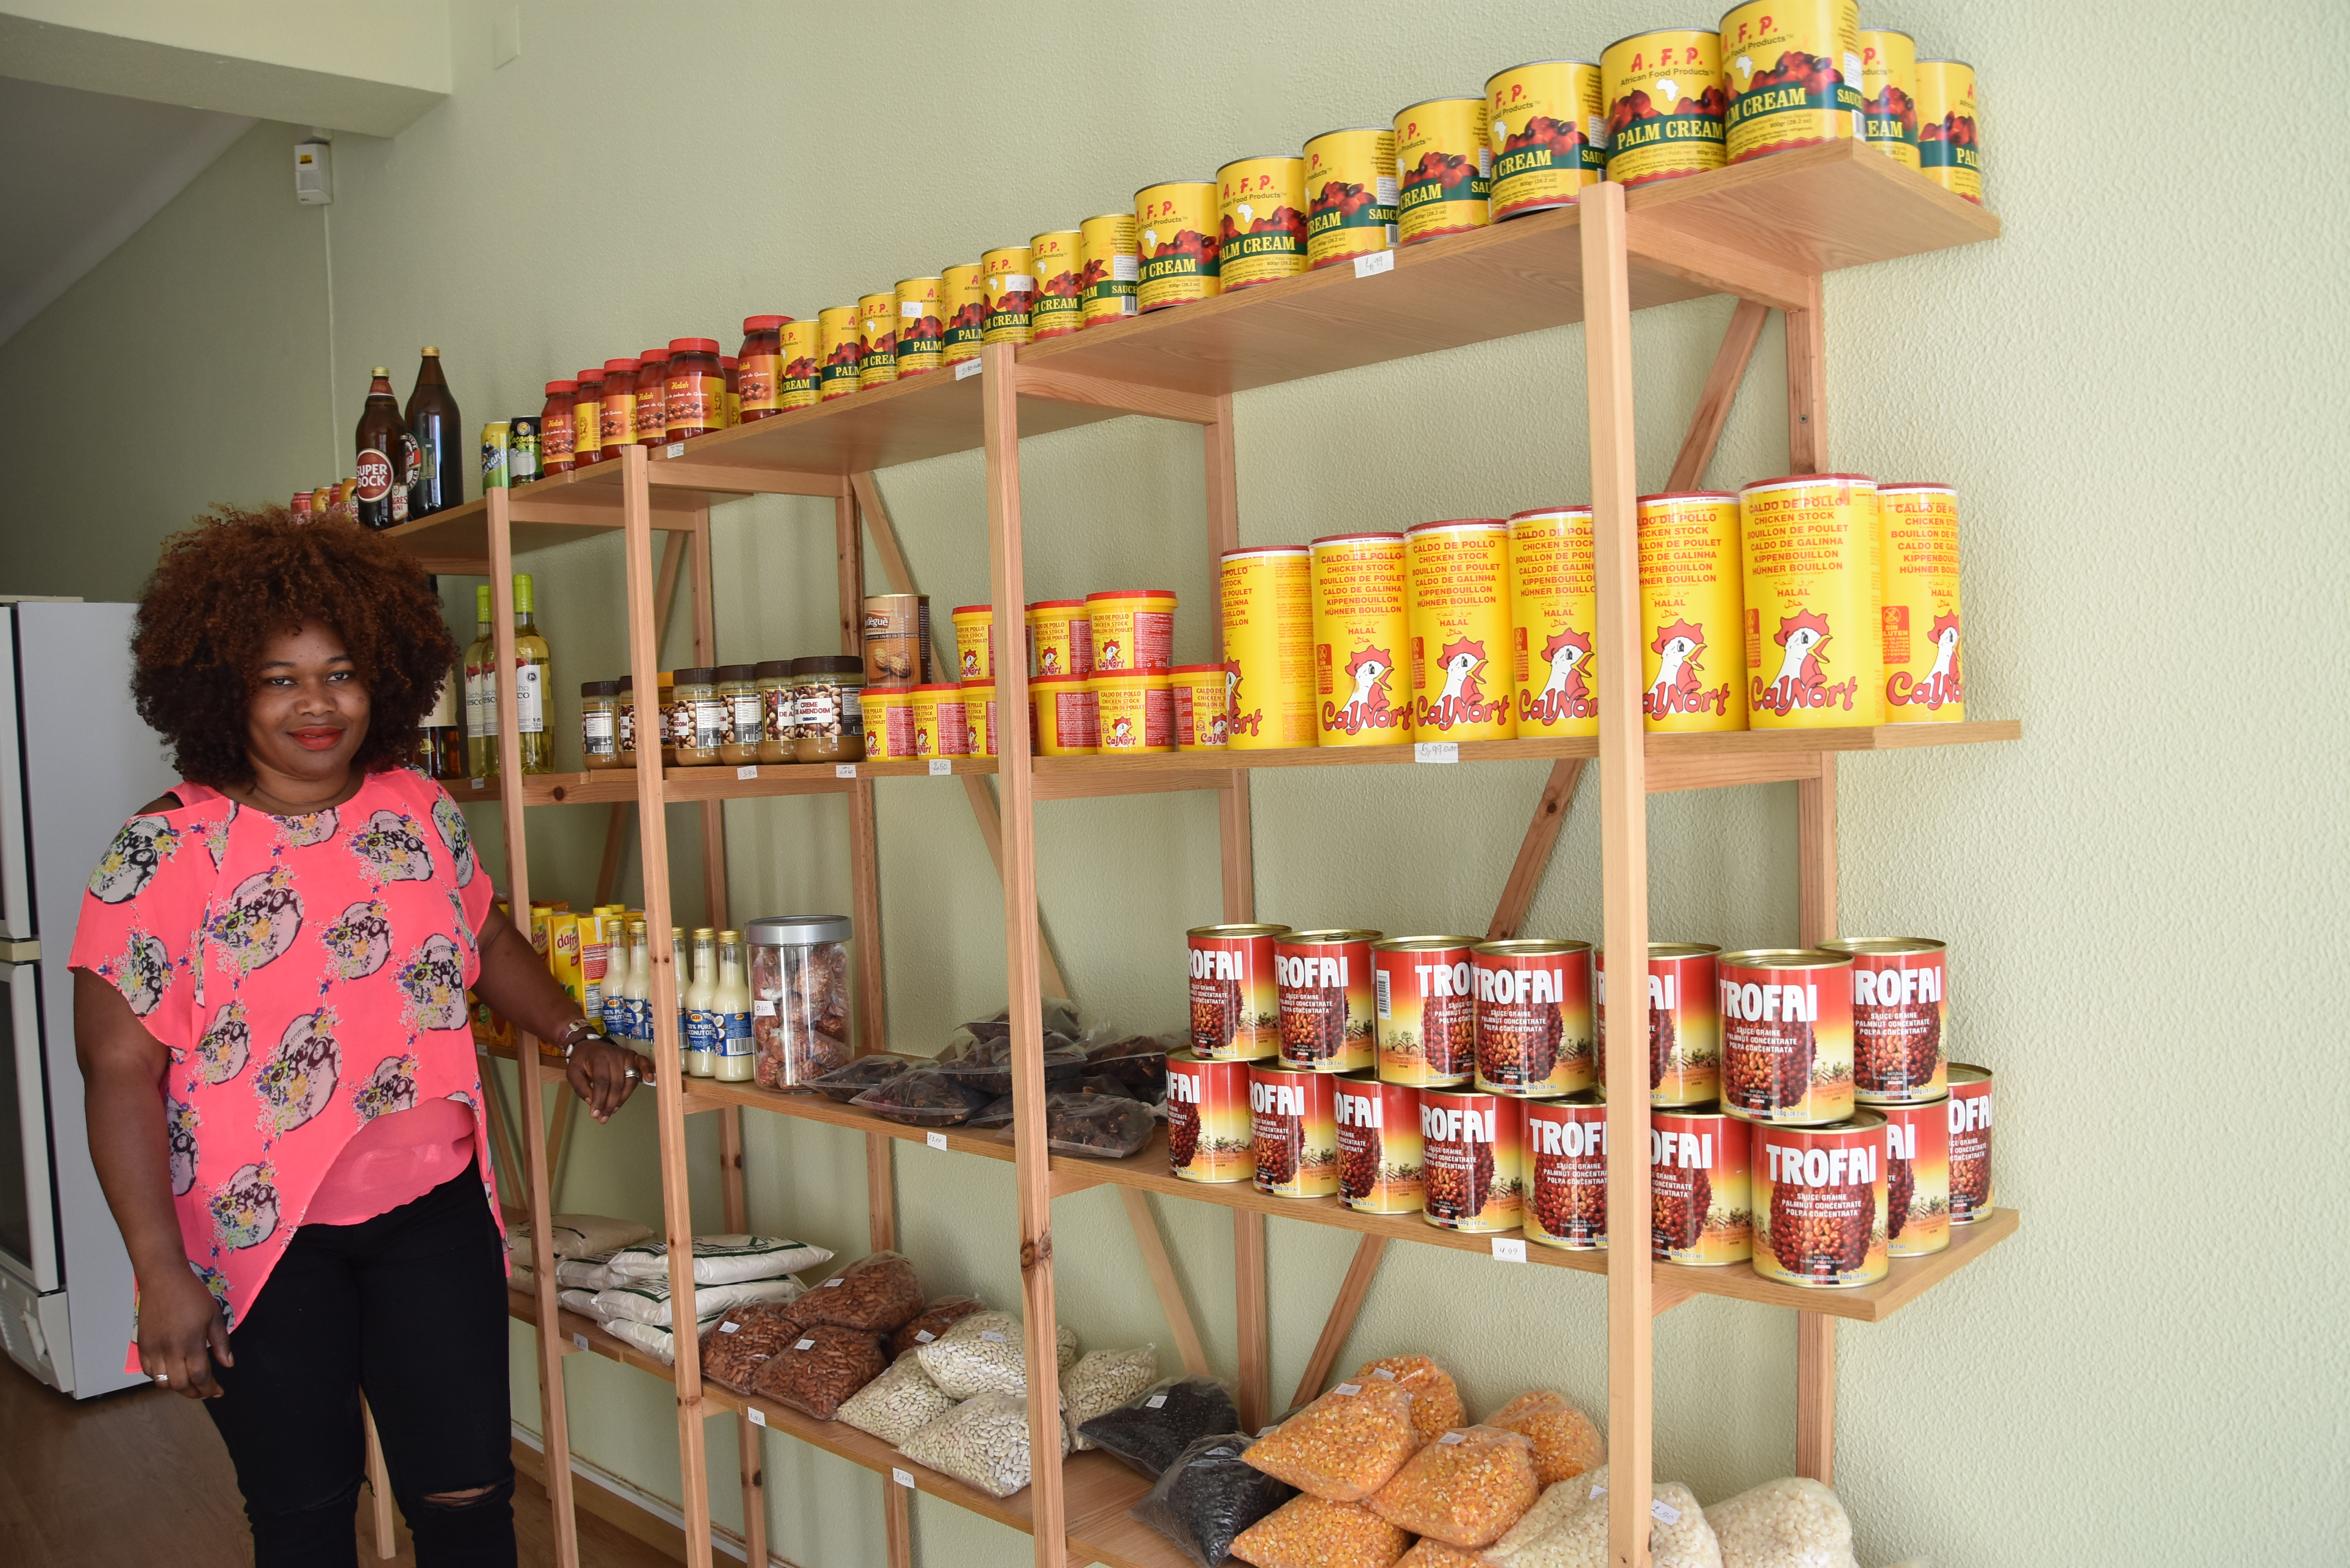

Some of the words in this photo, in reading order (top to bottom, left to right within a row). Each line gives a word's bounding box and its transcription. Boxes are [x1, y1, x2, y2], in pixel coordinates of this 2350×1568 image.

[1731, 45, 1746, 57] Food
[1620, 75, 1647, 87] African
[1649, 68, 1671, 80] Food
[1743, 88, 1807, 117] CREAM
[1837, 89, 1862, 110] SAUCE
[1617, 123, 1661, 151] PALM
[1666, 121, 1724, 141] CREAM
[1499, 150, 1552, 174] CREAM
[1401, 183, 1442, 211] CREAM
[1142, 222, 1153, 231] Food
[1243, 236, 1296, 254] CREAM
[1149, 259, 1196, 278] CREAM
[1112, 285, 1137, 294] SAUCE
[1041, 298, 1078, 312] CREAM
[993, 314, 1029, 327] CREAM
[913, 341, 942, 352] PALM
[783, 379, 810, 391] CREAM
[356, 464, 388, 476] SUPER
[357, 475, 387, 488] BOCK
[1749, 500, 1779, 514] CALDO
[1783, 499, 1798, 509] DE
[1803, 497, 1842, 507] POLLO
[1755, 514, 1794, 525] CHICKEN
[1798, 512, 1835, 521] STOCK
[1747, 527, 1786, 539] BOUILLON
[1790, 526, 1804, 534] DE
[1808, 525, 1848, 533] POULET
[1413, 543, 1441, 554] CALDO
[1444, 541, 1458, 550] DE
[1461, 540, 1495, 549] POLLO
[1751, 540, 1777, 551] CALDO
[1780, 539, 1793, 548] DE
[1797, 537, 1844, 547] GALINHA
[1419, 554, 1455, 564] CHICKEN
[1457, 552, 1489, 560] STOCK
[1754, 550, 1838, 563] KIPPENBOUILLON
[1328, 564, 1363, 574] CHICKEN
[1412, 566, 1447, 577] BOUILLON
[1753, 564, 1786, 575] HÜHNER
[1789, 562, 1843, 572] BOUILLON
[1415, 577, 1439, 587] CALDO
[1457, 574, 1496, 583] GALINHA
[1419, 585, 1493, 598] KIPPENBOUILLON
[1777, 588, 1810, 597] HALAL
[1417, 598, 1447, 608] HÜHNER
[1450, 596, 1496, 605] BOUILLON
[1439, 618, 1469, 627] HALAL
[1098, 658, 1125, 670] CalNort
[1752, 675, 1858, 717] CalNort
[1886, 671, 1962, 711] CalNo
[1642, 679, 1730, 721] alNort
[1322, 700, 1414, 735] CalNort
[1416, 694, 1510, 731] CalNort
[1106, 734, 1137, 746] CalNort
[1274, 954, 1349, 988] TROFAI
[1414, 962, 1471, 997] TRO
[1472, 966, 1563, 1005] TROFAI
[1855, 966, 1941, 1007] ROFAI
[1720, 978, 1817, 1022] TROFAI
[1490, 1009, 1507, 1018] SAUCE
[1888, 1018, 1930, 1028] CONCENTRATE
[1736, 1027, 1755, 1035] SAUCE
[1883, 1027, 1927, 1035] CONCENTRATA
[1727, 1033, 1748, 1043] PALMNUT
[1750, 1036, 1798, 1045] CONCENTRATE
[1746, 1044, 1793, 1053] CONCENTRATA
[1334, 1092, 1382, 1128] OFAI
[1419, 1102, 1494, 1143] TROFAI
[1529, 1118, 1607, 1157] TROF
[1766, 1143, 1876, 1188] TROFAI
[1796, 1193, 1819, 1201] SAUCE
[1782, 1199, 1813, 1209] PALMNUT
[1815, 1201, 1862, 1209] CONCENTRATE
